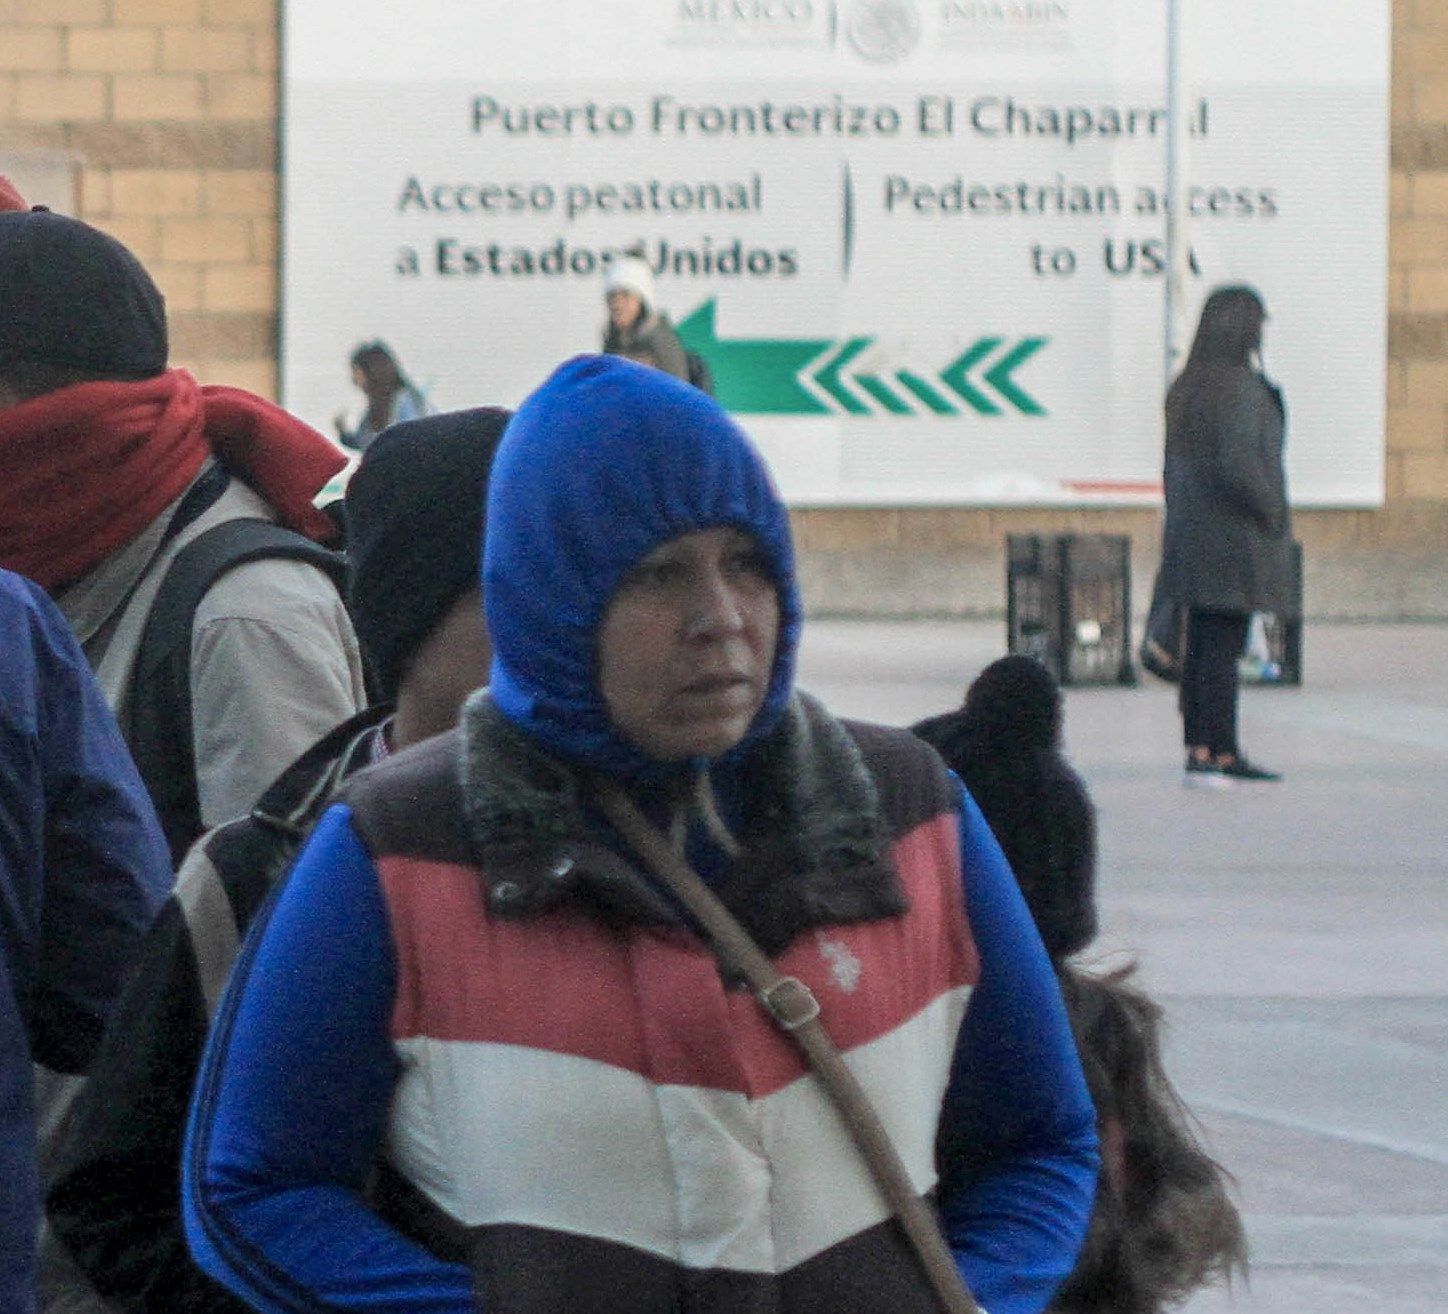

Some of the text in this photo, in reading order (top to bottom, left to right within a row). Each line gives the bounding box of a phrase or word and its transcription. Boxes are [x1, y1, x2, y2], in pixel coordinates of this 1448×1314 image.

[470, 95, 1209, 144] Puerto Fronterizo El Chaparrl
[397, 173, 762, 219] Acceso peatonal
[885, 174, 1278, 217] Pedestrian acess
[396, 247, 420, 275] a
[1031, 243, 1077, 276] to
